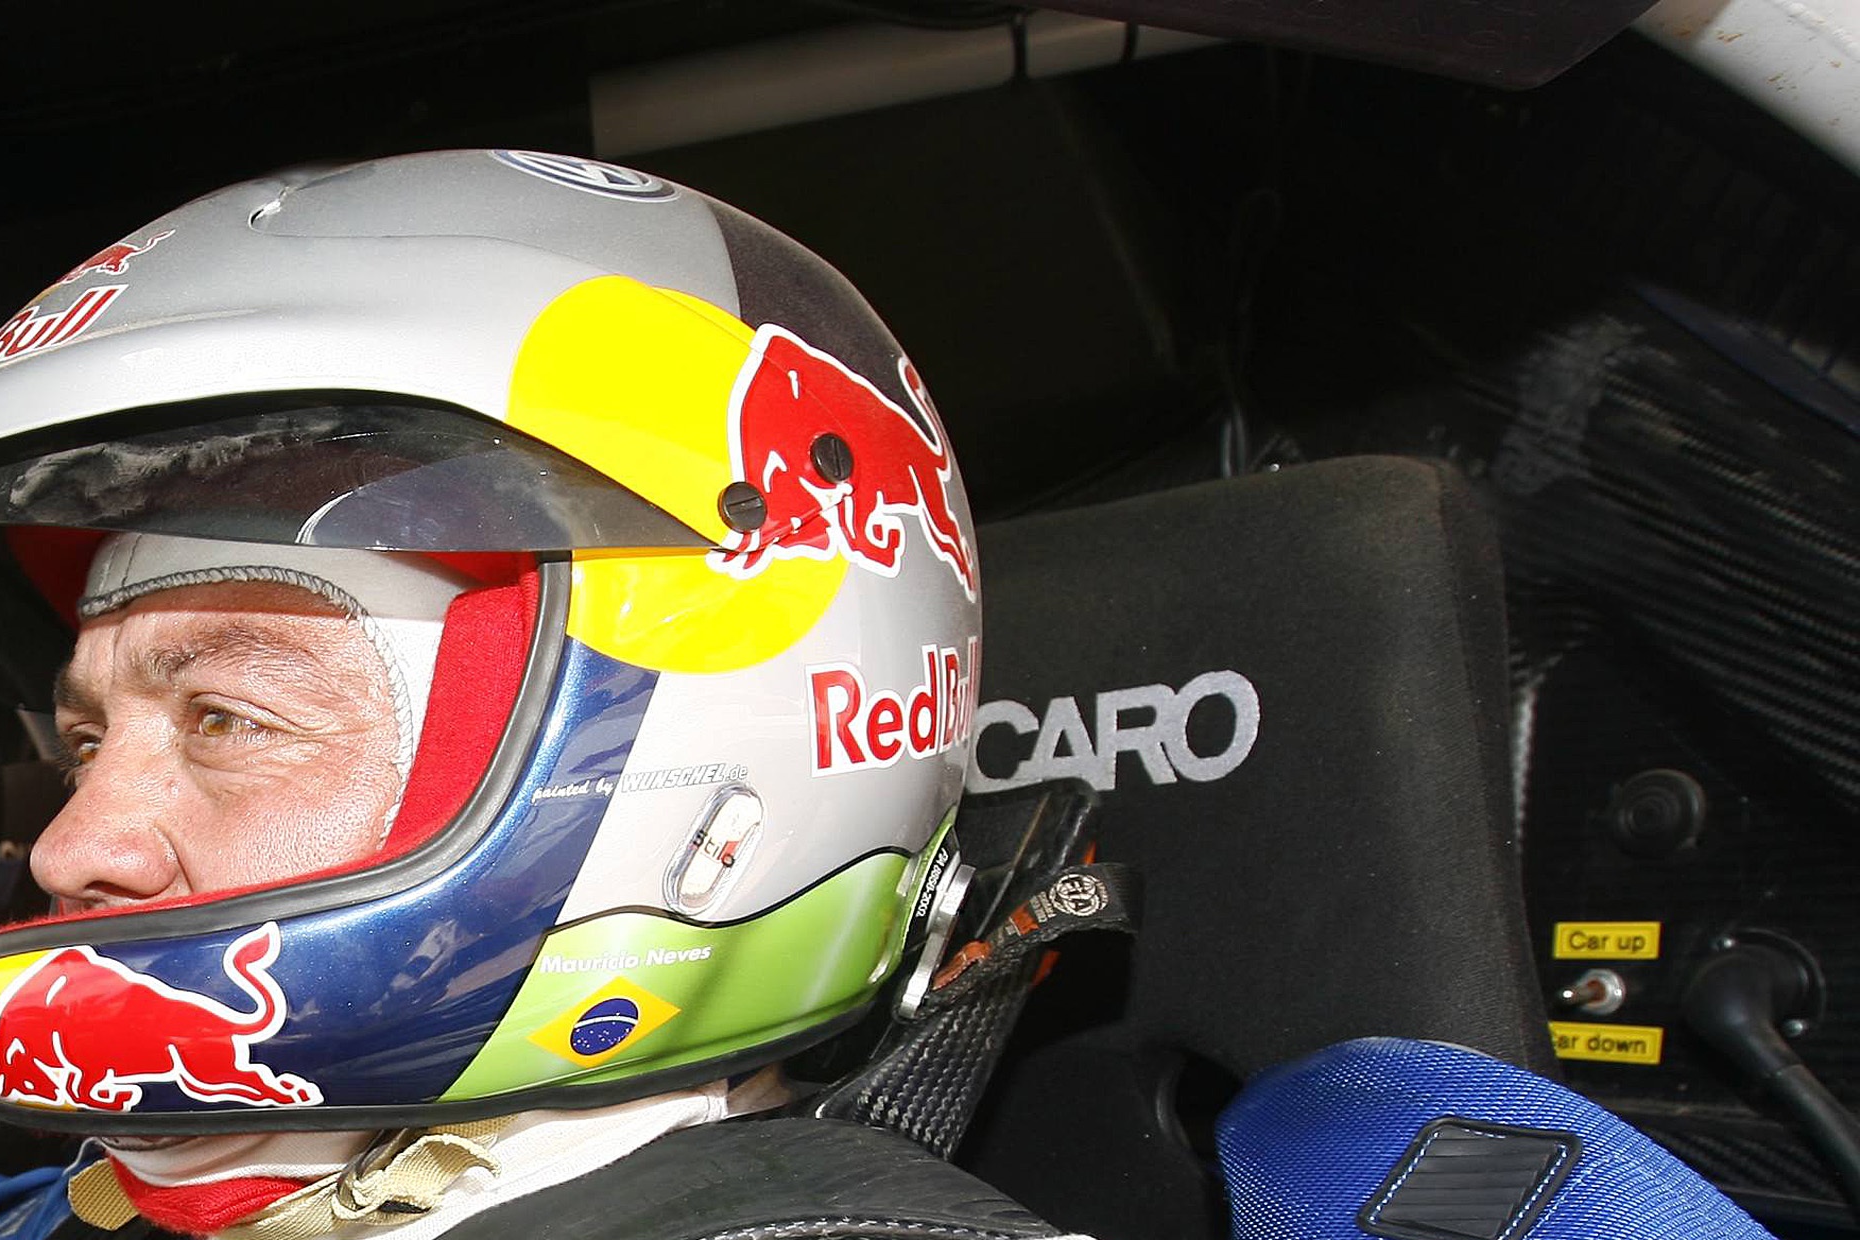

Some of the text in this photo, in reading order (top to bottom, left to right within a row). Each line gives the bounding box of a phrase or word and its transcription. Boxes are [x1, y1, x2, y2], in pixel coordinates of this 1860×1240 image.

[805, 645, 938, 777] Red
[966, 670, 1261, 794] CARO
[532, 782, 590, 805] painted
[596, 777, 615, 797] by
[645, 945, 713, 967] Neves
[1569, 931, 1646, 956] Car up
[1588, 1034, 1648, 1056] down
